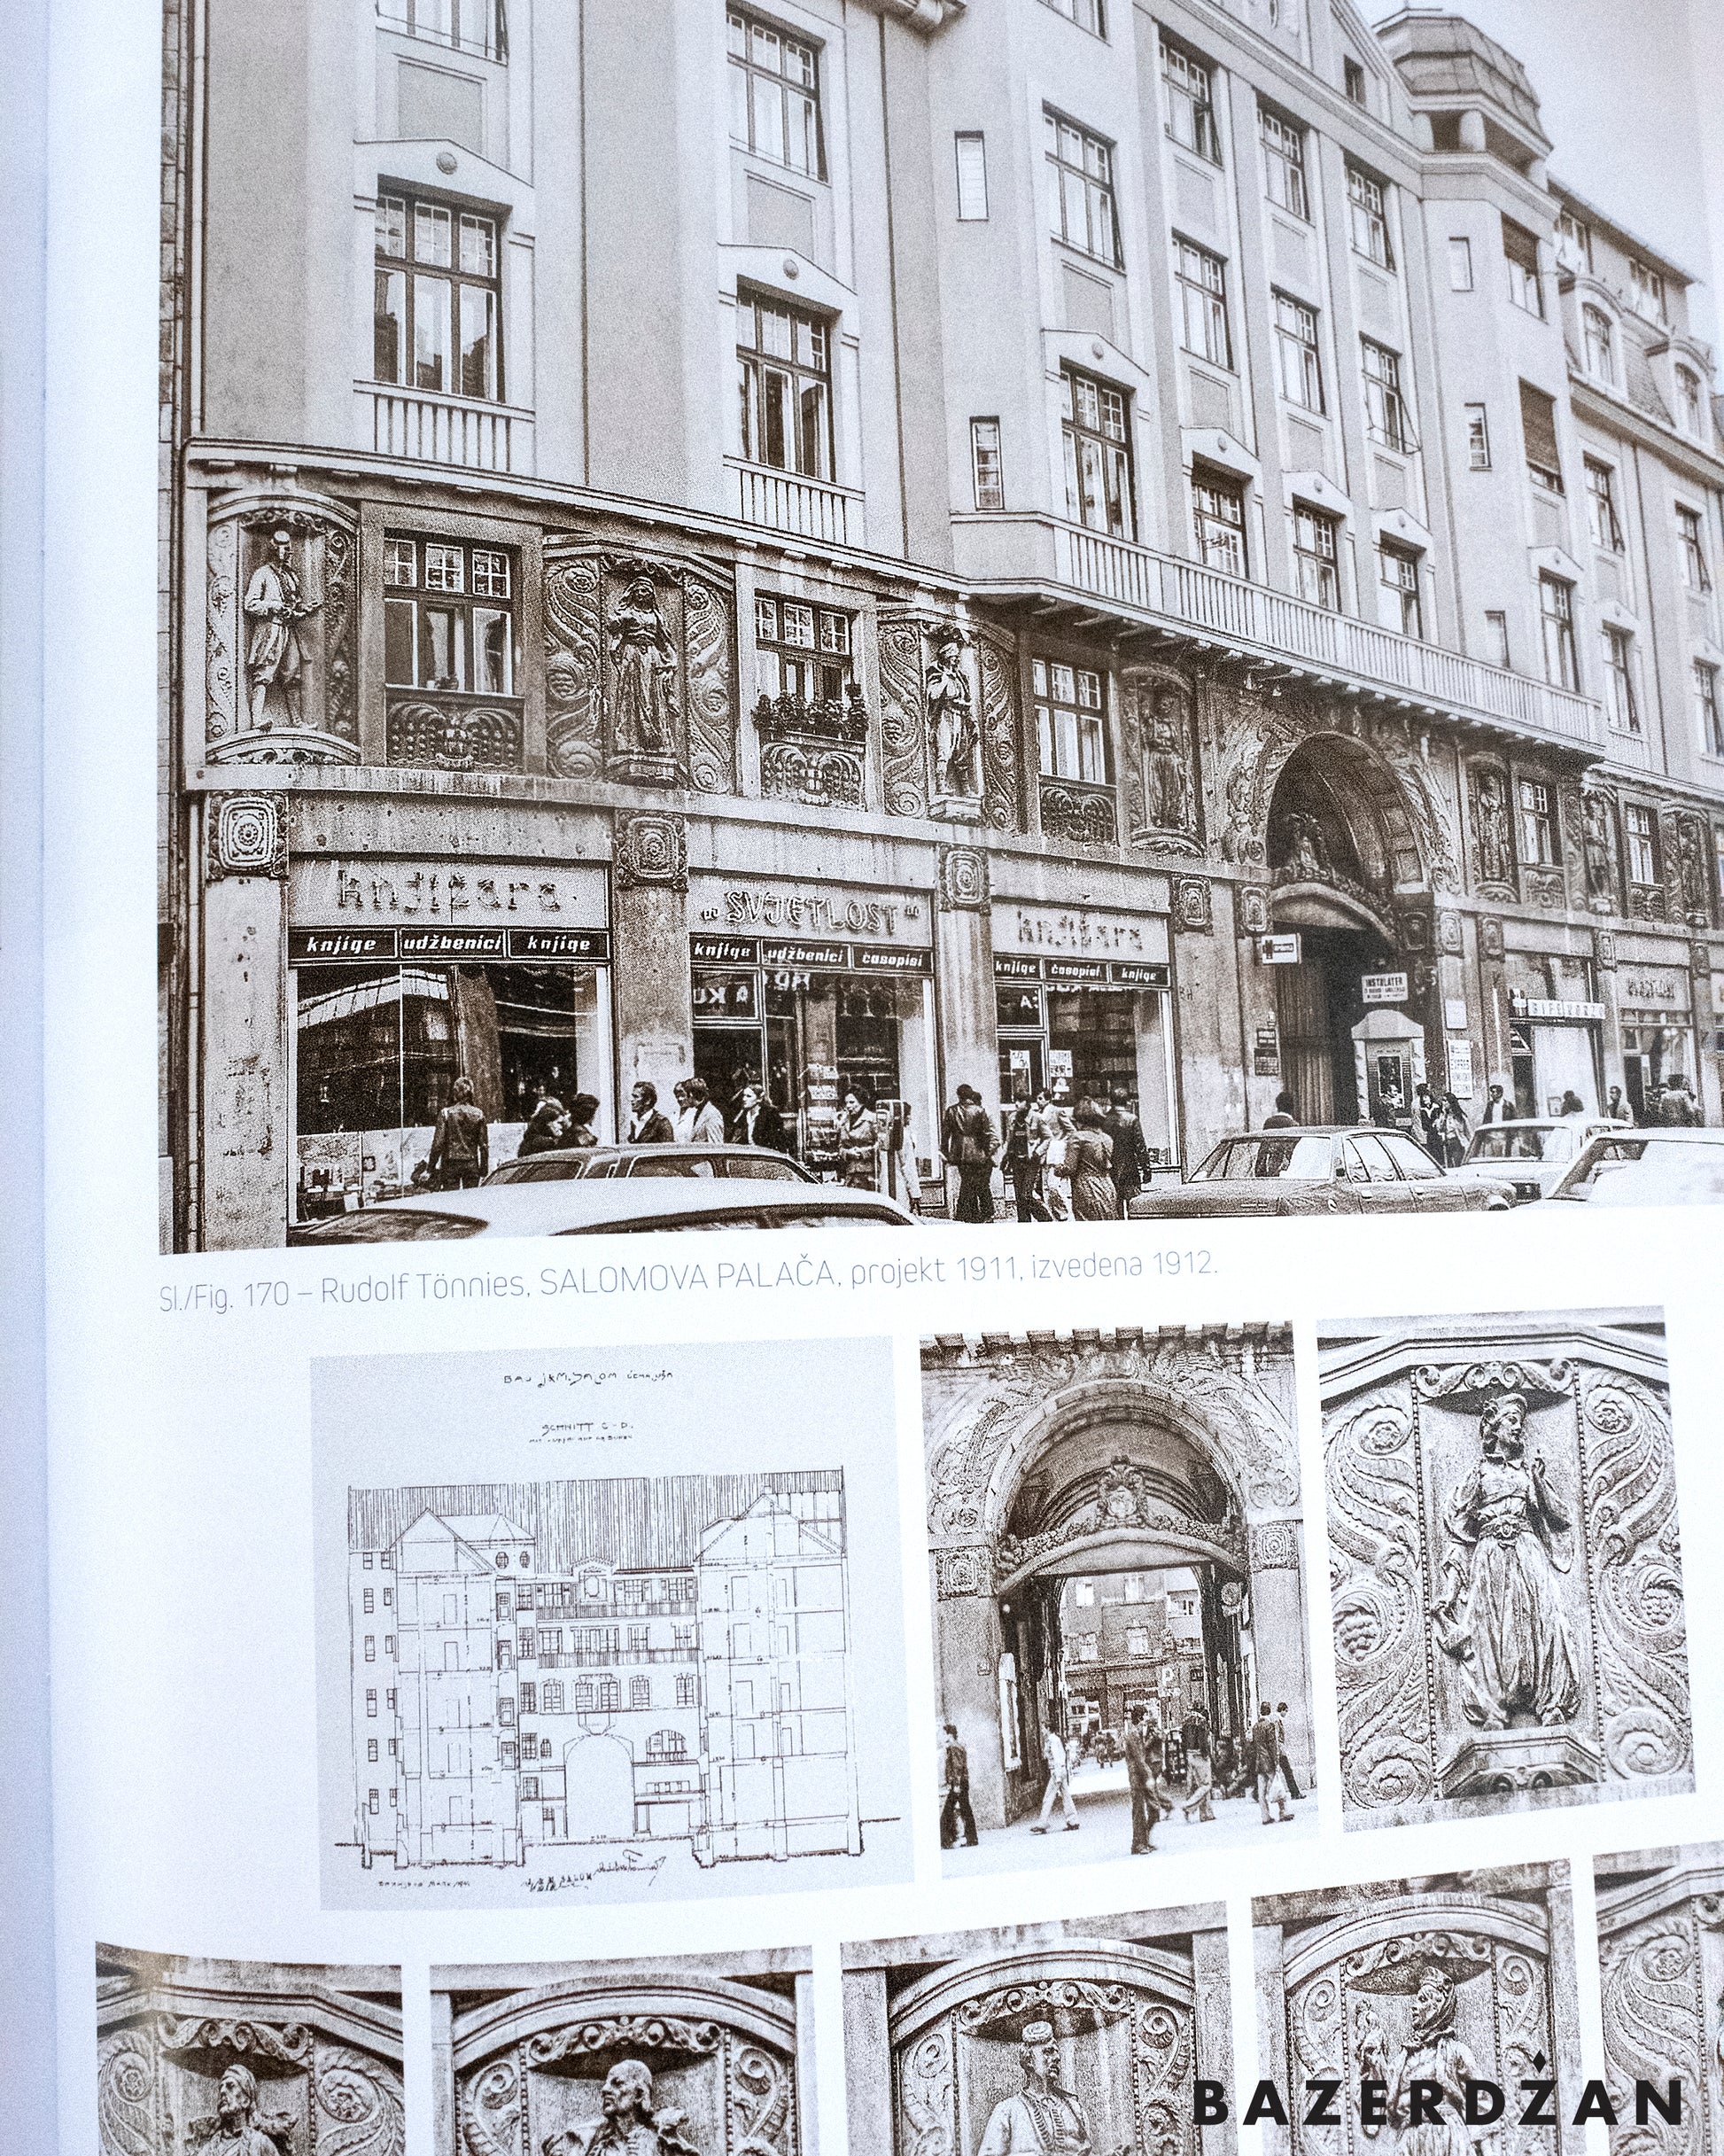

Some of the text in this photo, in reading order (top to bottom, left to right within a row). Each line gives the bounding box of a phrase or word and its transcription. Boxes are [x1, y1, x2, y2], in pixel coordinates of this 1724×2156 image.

[307, 936, 377, 955] knjige
[403, 934, 503, 951] udžbenici
[527, 935, 591, 953] knjige
[695, 942, 751, 961] knjige
[767, 946, 843, 963] udžbenici
[862, 951, 923, 968] časopisi
[996, 961, 1037, 976] knjige
[1052, 963, 1101, 978] časopisi
[1122, 968, 1157, 982] knjige
[159, 1283, 233, 1315] Sl./Fig.
[245, 1280, 290, 1307] 170
[322, 1273, 409, 1303] Rudolf
[416, 1272, 532, 1299] Tönnies,
[540, 1264, 708, 1296] SALOMOVA
[718, 1253, 842, 1288] PALAČA,
[851, 1255, 946, 1289] projekt
[957, 1256, 1023, 1281] 1911,
[1032, 1251, 1142, 1280] izvedena
[1153, 1249, 1218, 1275] 1912.
